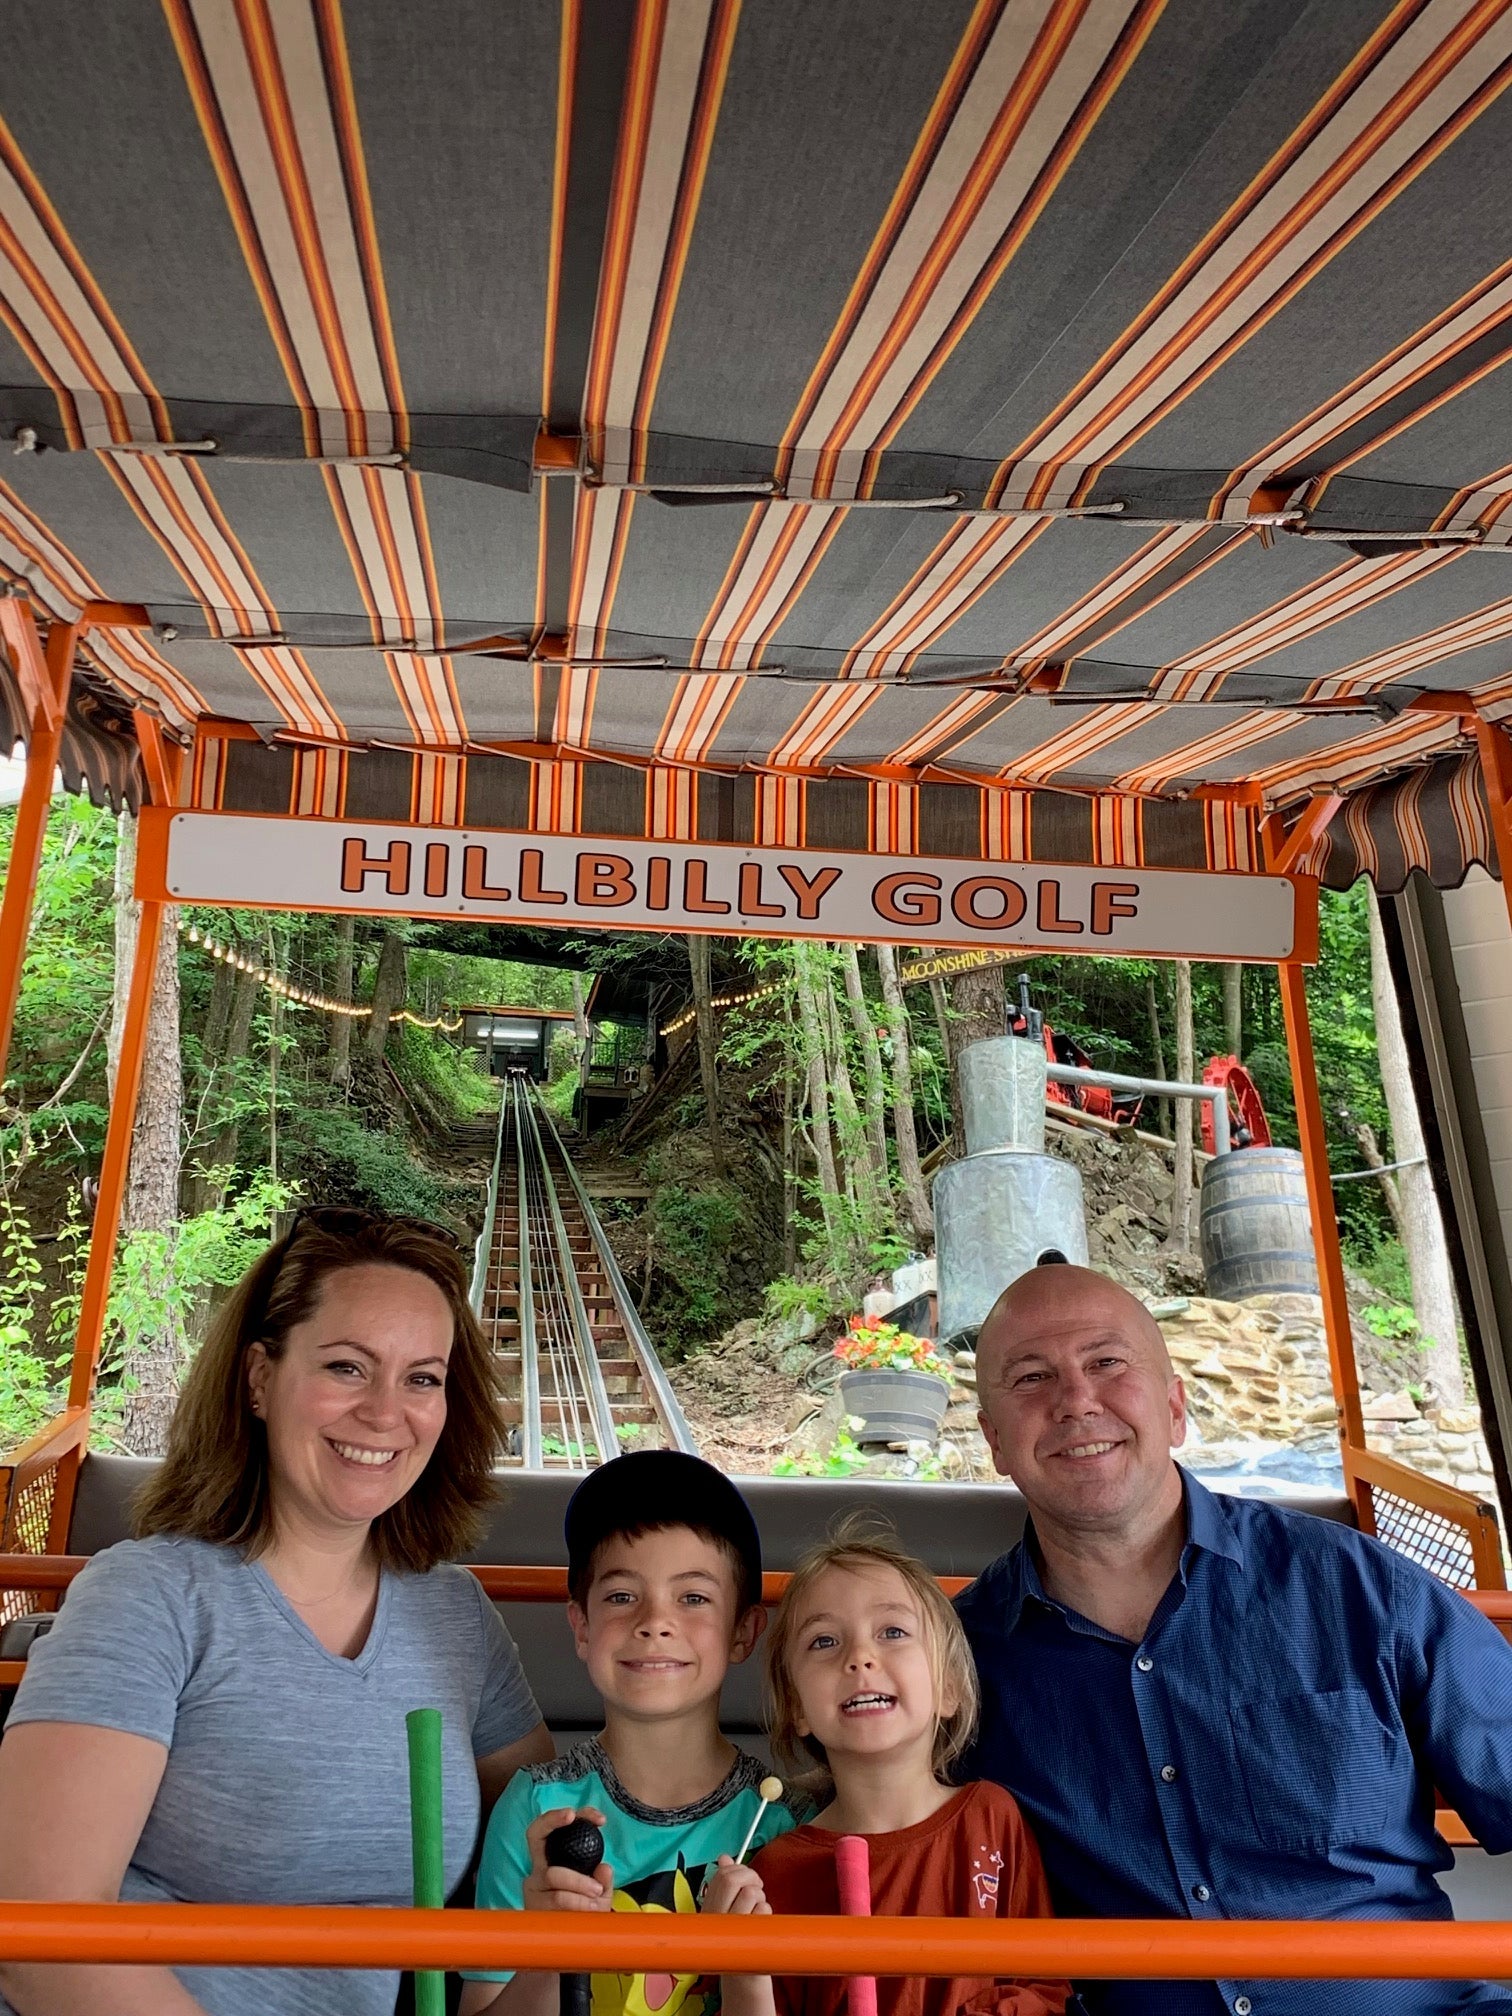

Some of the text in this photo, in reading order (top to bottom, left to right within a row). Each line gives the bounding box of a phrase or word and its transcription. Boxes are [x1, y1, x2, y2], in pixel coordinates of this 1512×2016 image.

[340, 838, 1140, 935] HILLBILLY GOLF
[902, 950, 992, 981] MOONSHINE
